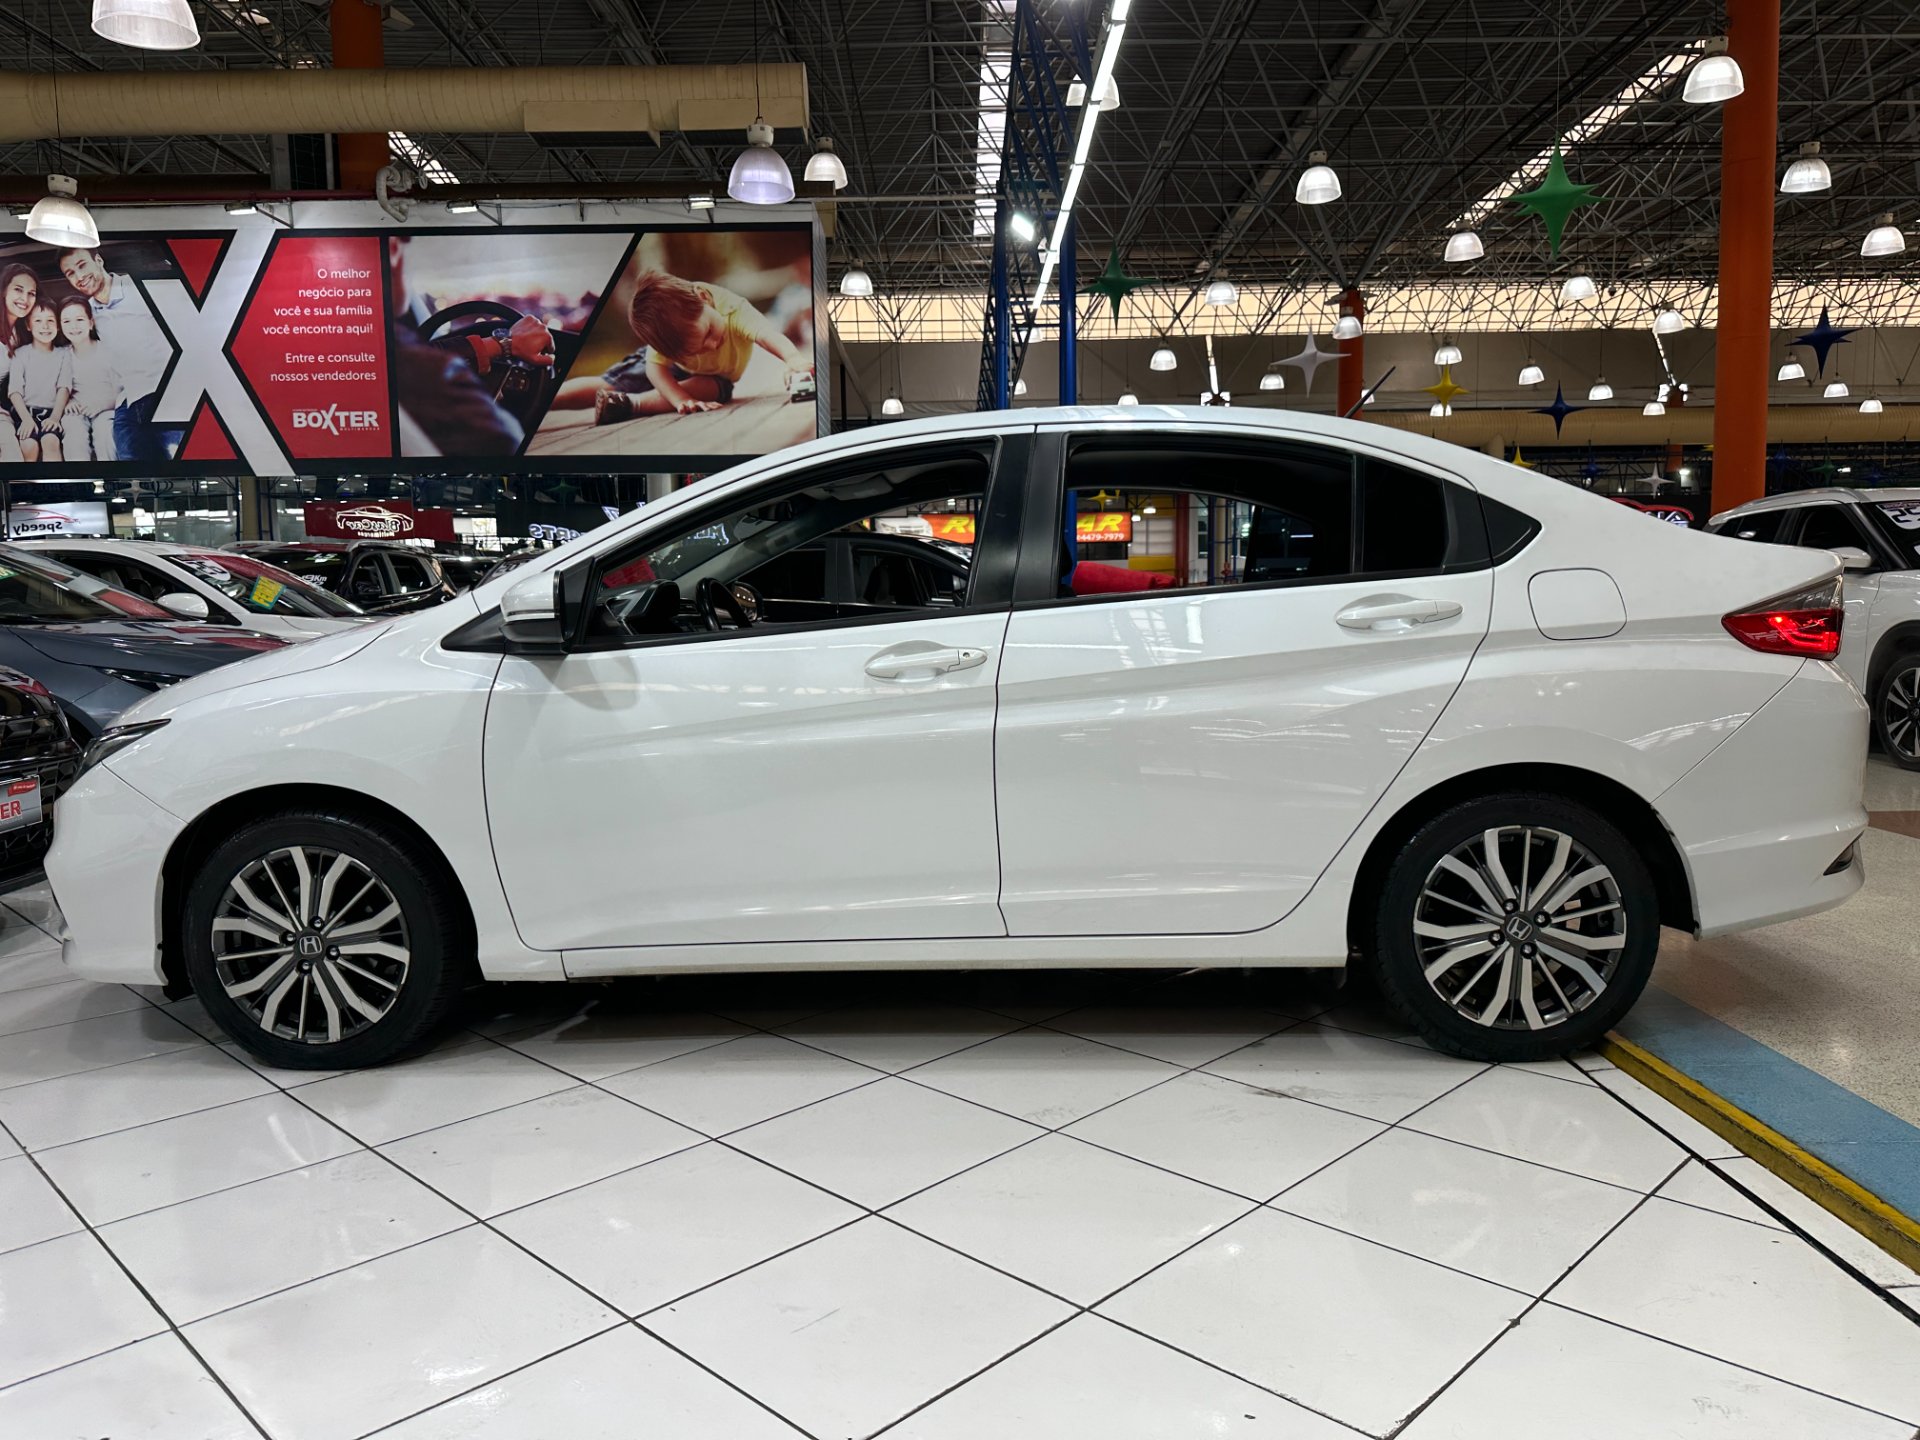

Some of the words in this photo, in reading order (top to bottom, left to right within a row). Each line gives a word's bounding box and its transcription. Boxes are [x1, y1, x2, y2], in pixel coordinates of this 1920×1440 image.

[317, 268, 328, 279] O
[330, 268, 371, 279] melhor
[298, 287, 345, 300] negócio
[347, 288, 372, 299] para
[273, 305, 301, 316] você
[303, 307, 311, 316] e
[313, 307, 333, 316] sua
[335, 304, 373, 316] família
[262, 324, 290, 335] você
[292, 323, 343, 335] encontra
[346, 323, 373, 336] aqui!
[285, 353, 315, 364] Entre
[317, 354, 325, 363] e
[327, 352, 376, 363] consulte
[270, 372, 309, 382] nossos
[311, 371, 377, 381] vendedores
[292, 403, 380, 436] BOXTER
[1076, 513, 1124, 532] AR
[0, 799, 22, 820] ER
